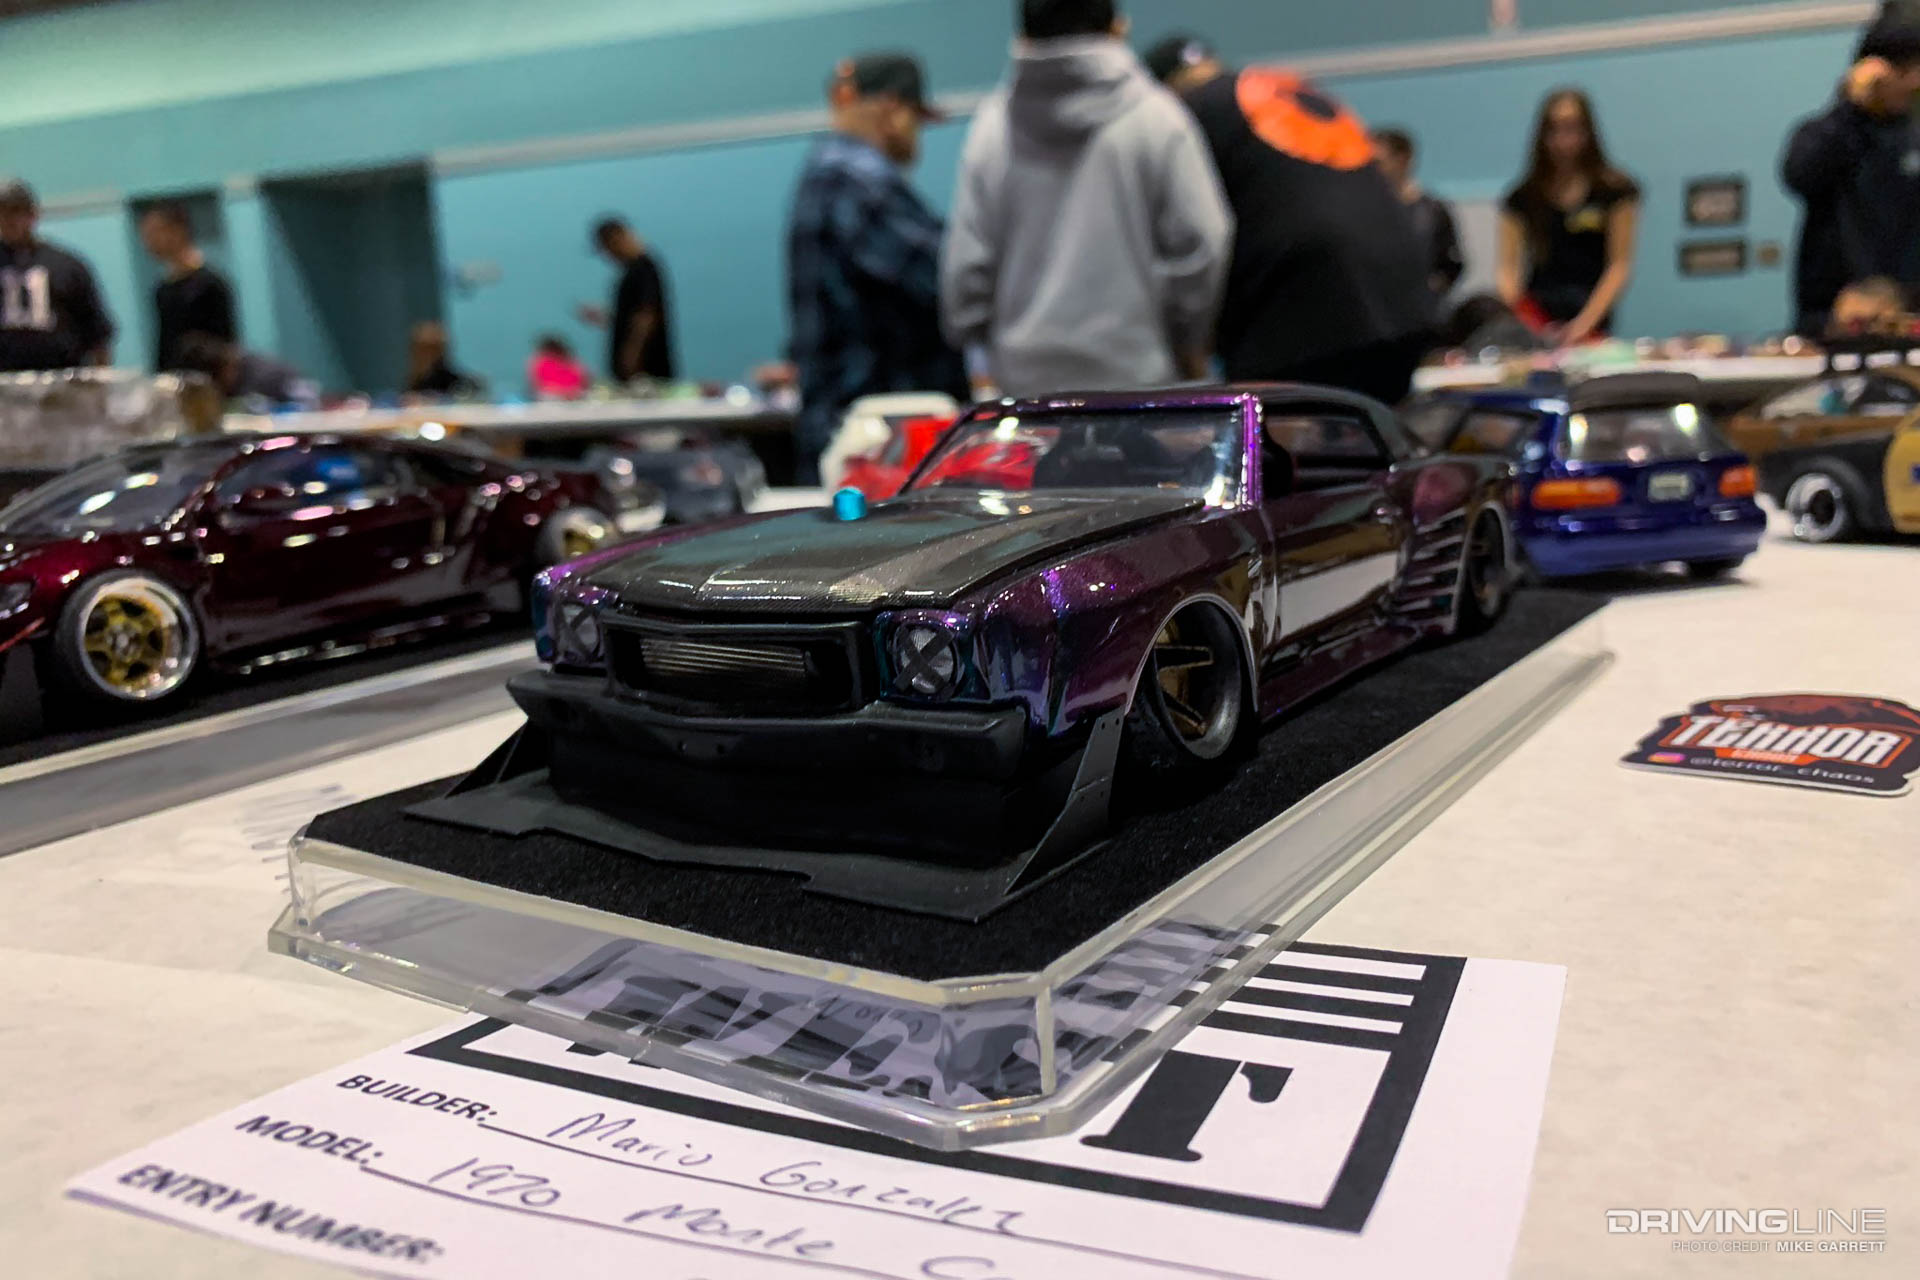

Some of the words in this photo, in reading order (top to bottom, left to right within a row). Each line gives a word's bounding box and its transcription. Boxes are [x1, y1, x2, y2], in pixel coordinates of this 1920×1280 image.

[1690, 756, 1876, 785] @terror_chaos
[336, 1074, 499, 1123] BUILDER:
[235, 1114, 384, 1166] MODEL:
[546, 1112, 713, 1166] Mario
[117, 1164, 257, 1212] ENTRY
[239, 1199, 446, 1265] NUMBER:
[428, 1157, 562, 1207] 1970
[622, 1203, 835, 1256] Monte
